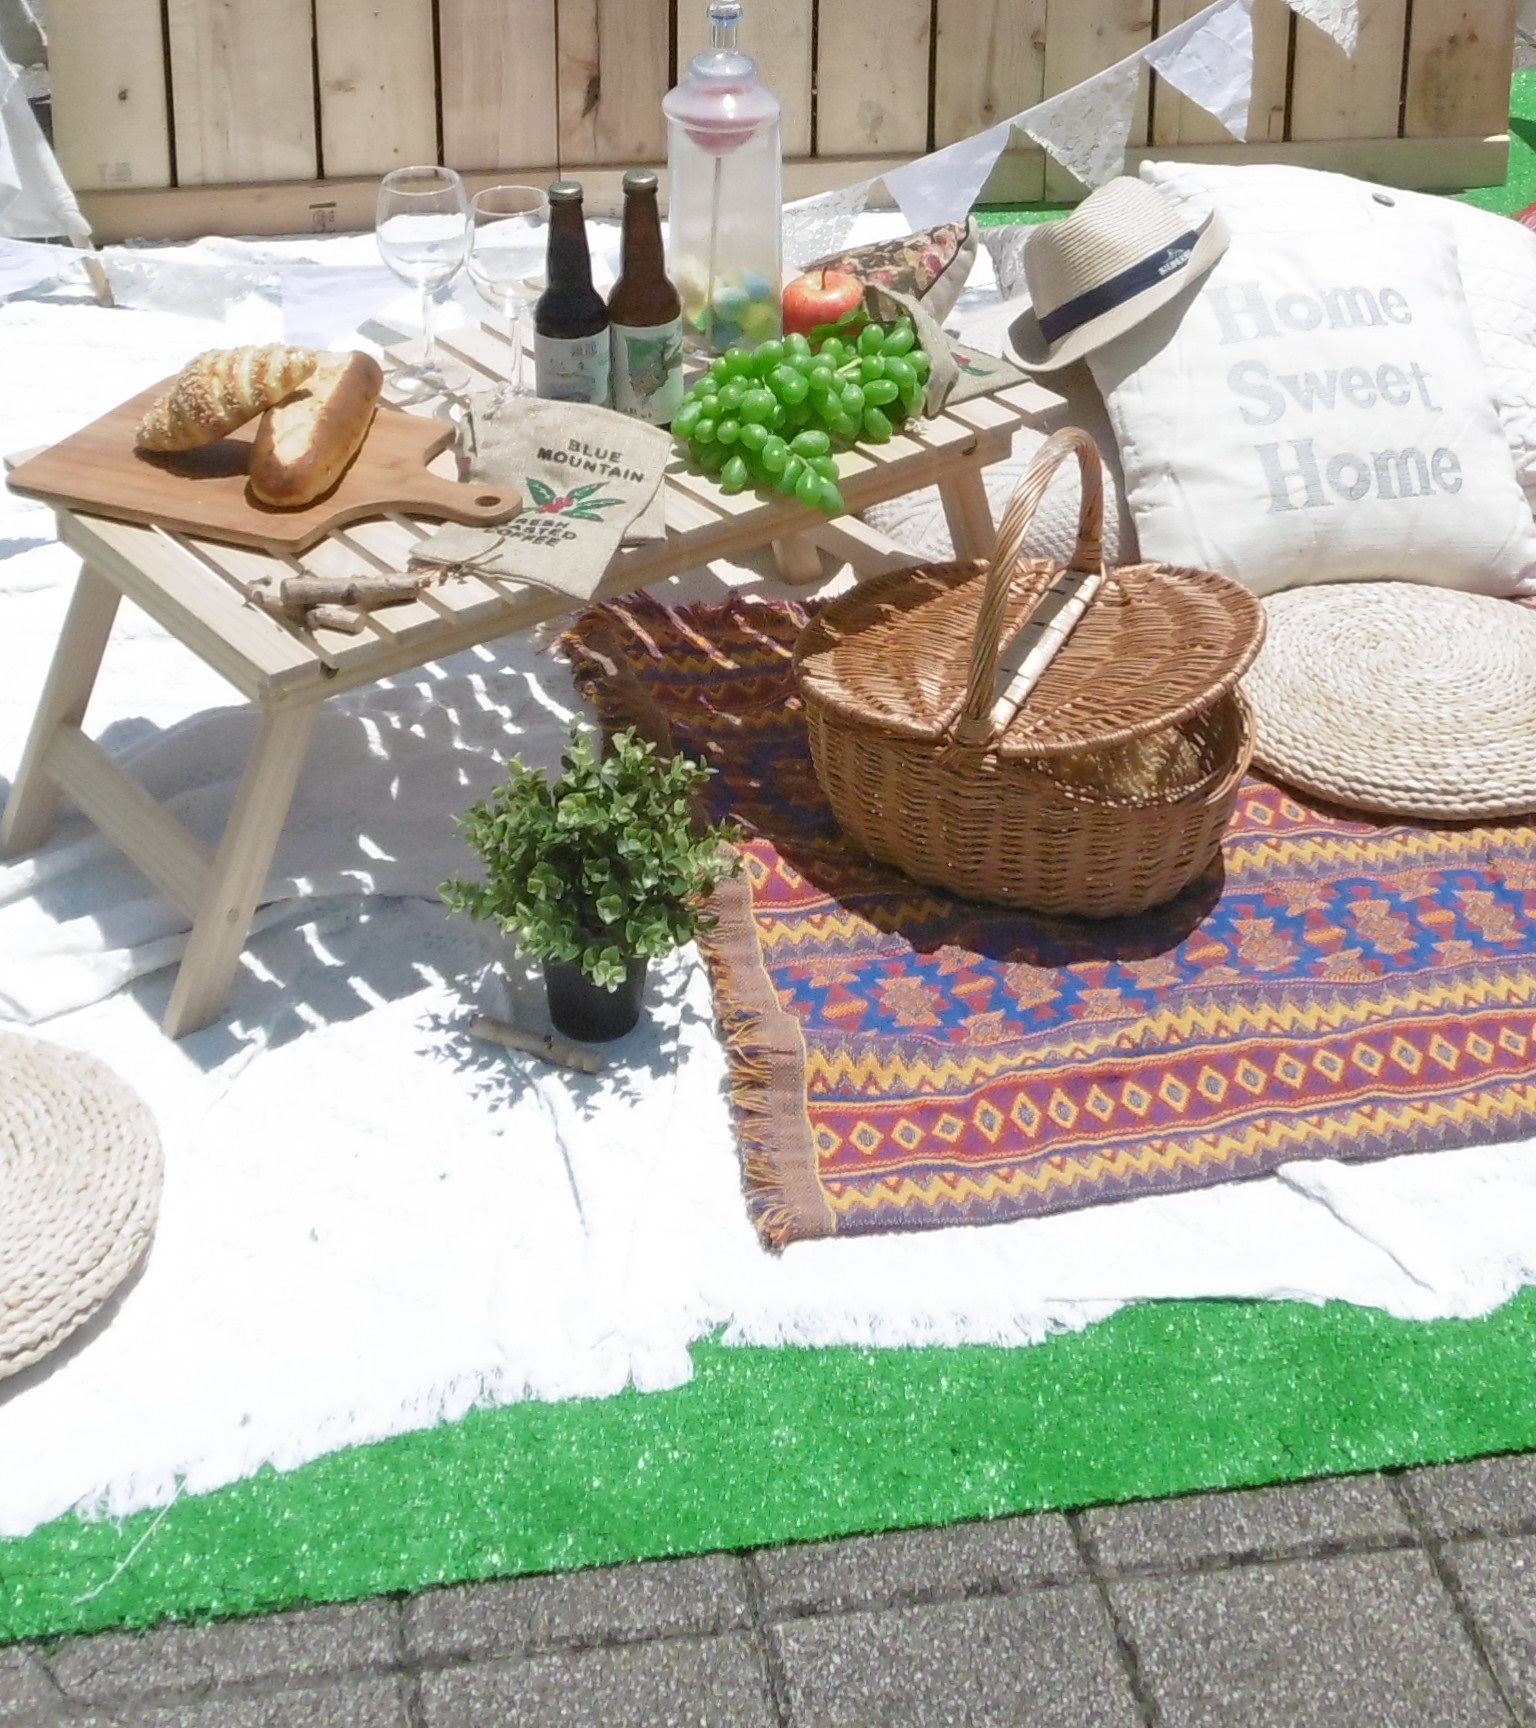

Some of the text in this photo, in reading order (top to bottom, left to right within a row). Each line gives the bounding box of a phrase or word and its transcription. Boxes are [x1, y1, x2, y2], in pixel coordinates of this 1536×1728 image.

[1206, 280, 1413, 346] Home
[1226, 359, 1444, 426] Sweet
[537, 446, 645, 483] MOUNTAIN
[567, 438, 622, 463] BLUE
[1253, 437, 1463, 513] Home
[512, 517, 571, 529] RESH
